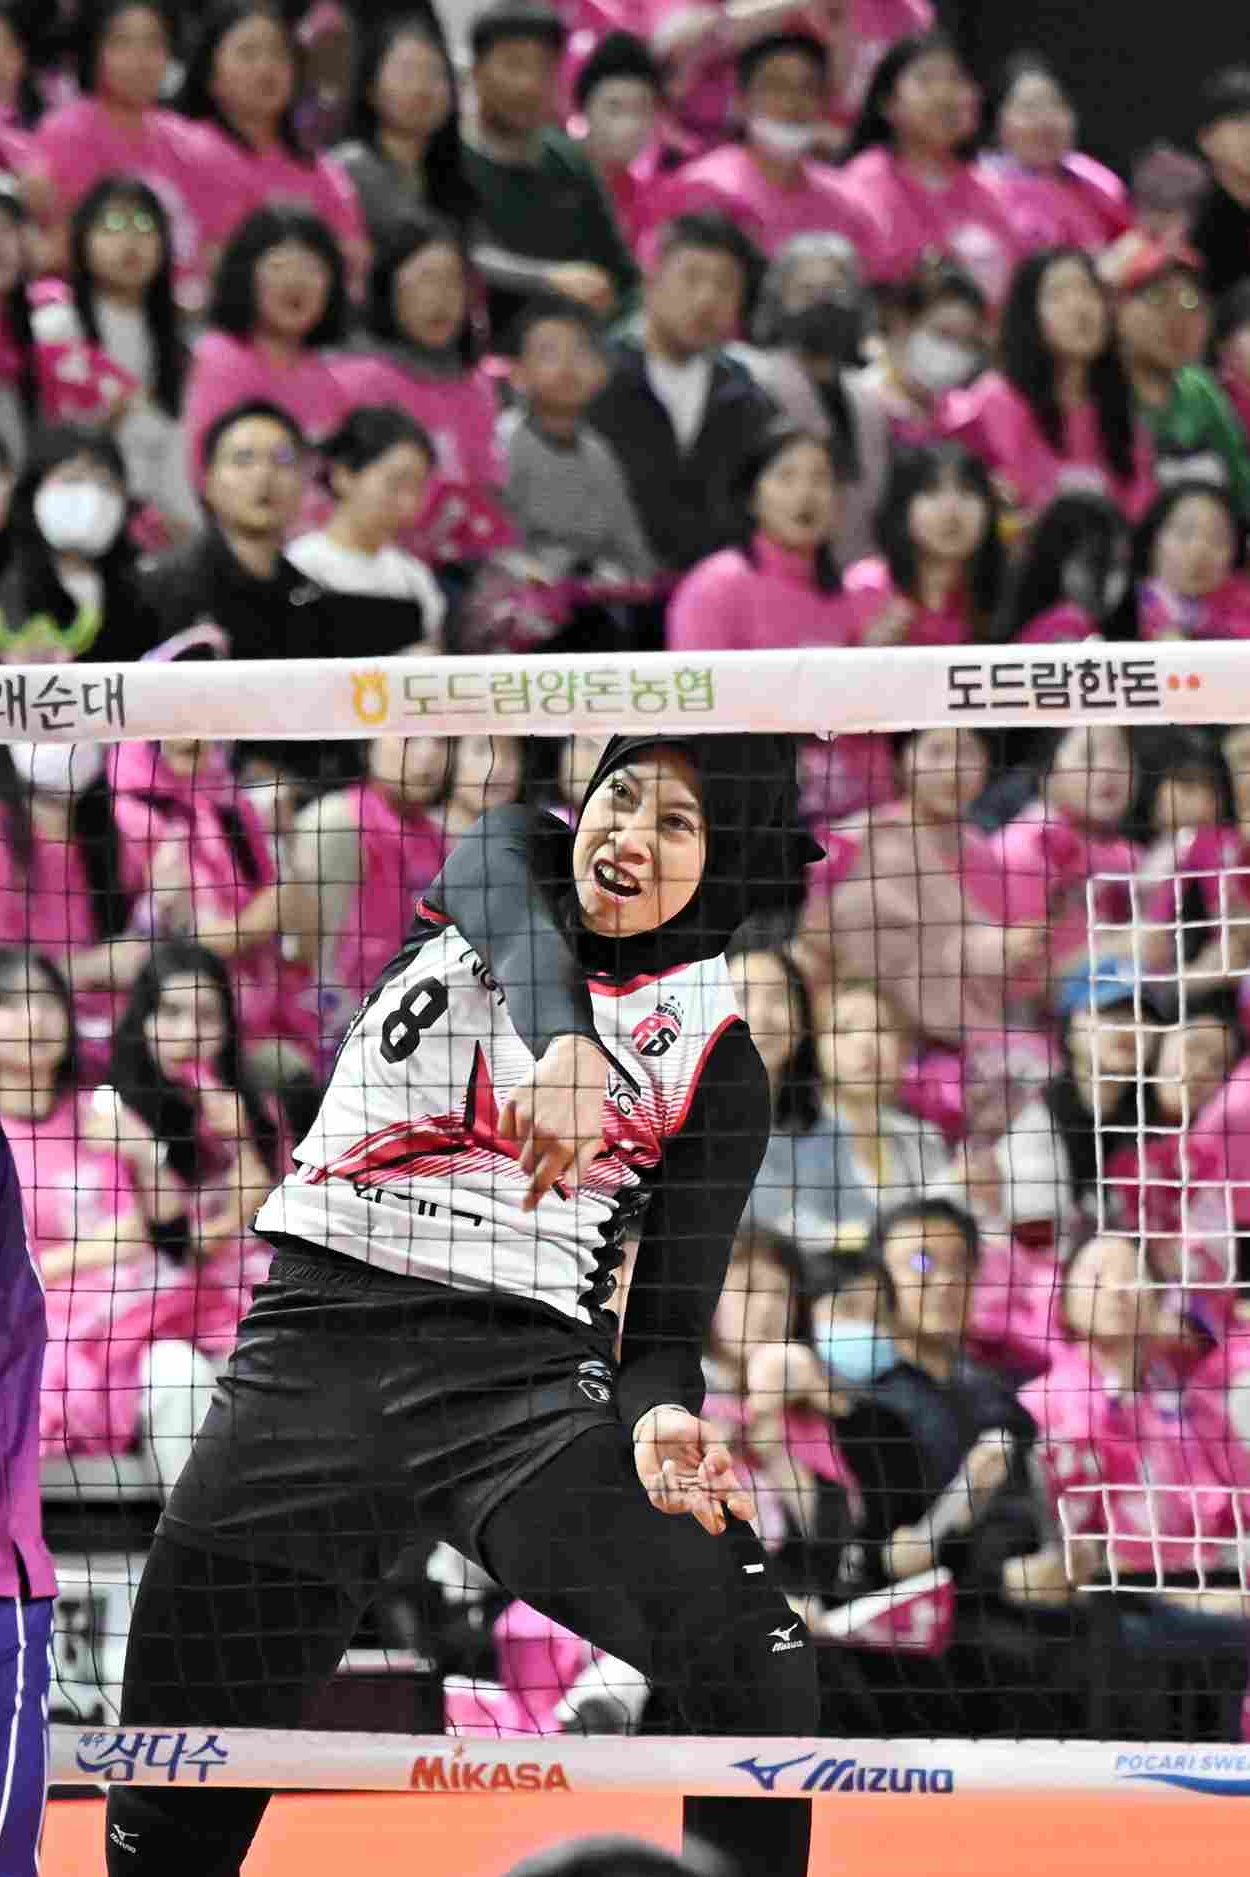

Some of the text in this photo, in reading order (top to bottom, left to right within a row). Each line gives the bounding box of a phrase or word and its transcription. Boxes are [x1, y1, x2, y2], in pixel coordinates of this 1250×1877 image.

[402, 667, 715, 716] 도드람양돈농협
[948, 659, 1160, 710] 도드람한돈
[380, 976, 449, 1064] 8
[76, 1732, 228, 1783] 삼다수
[1114, 1754, 1197, 1770] POCARI
